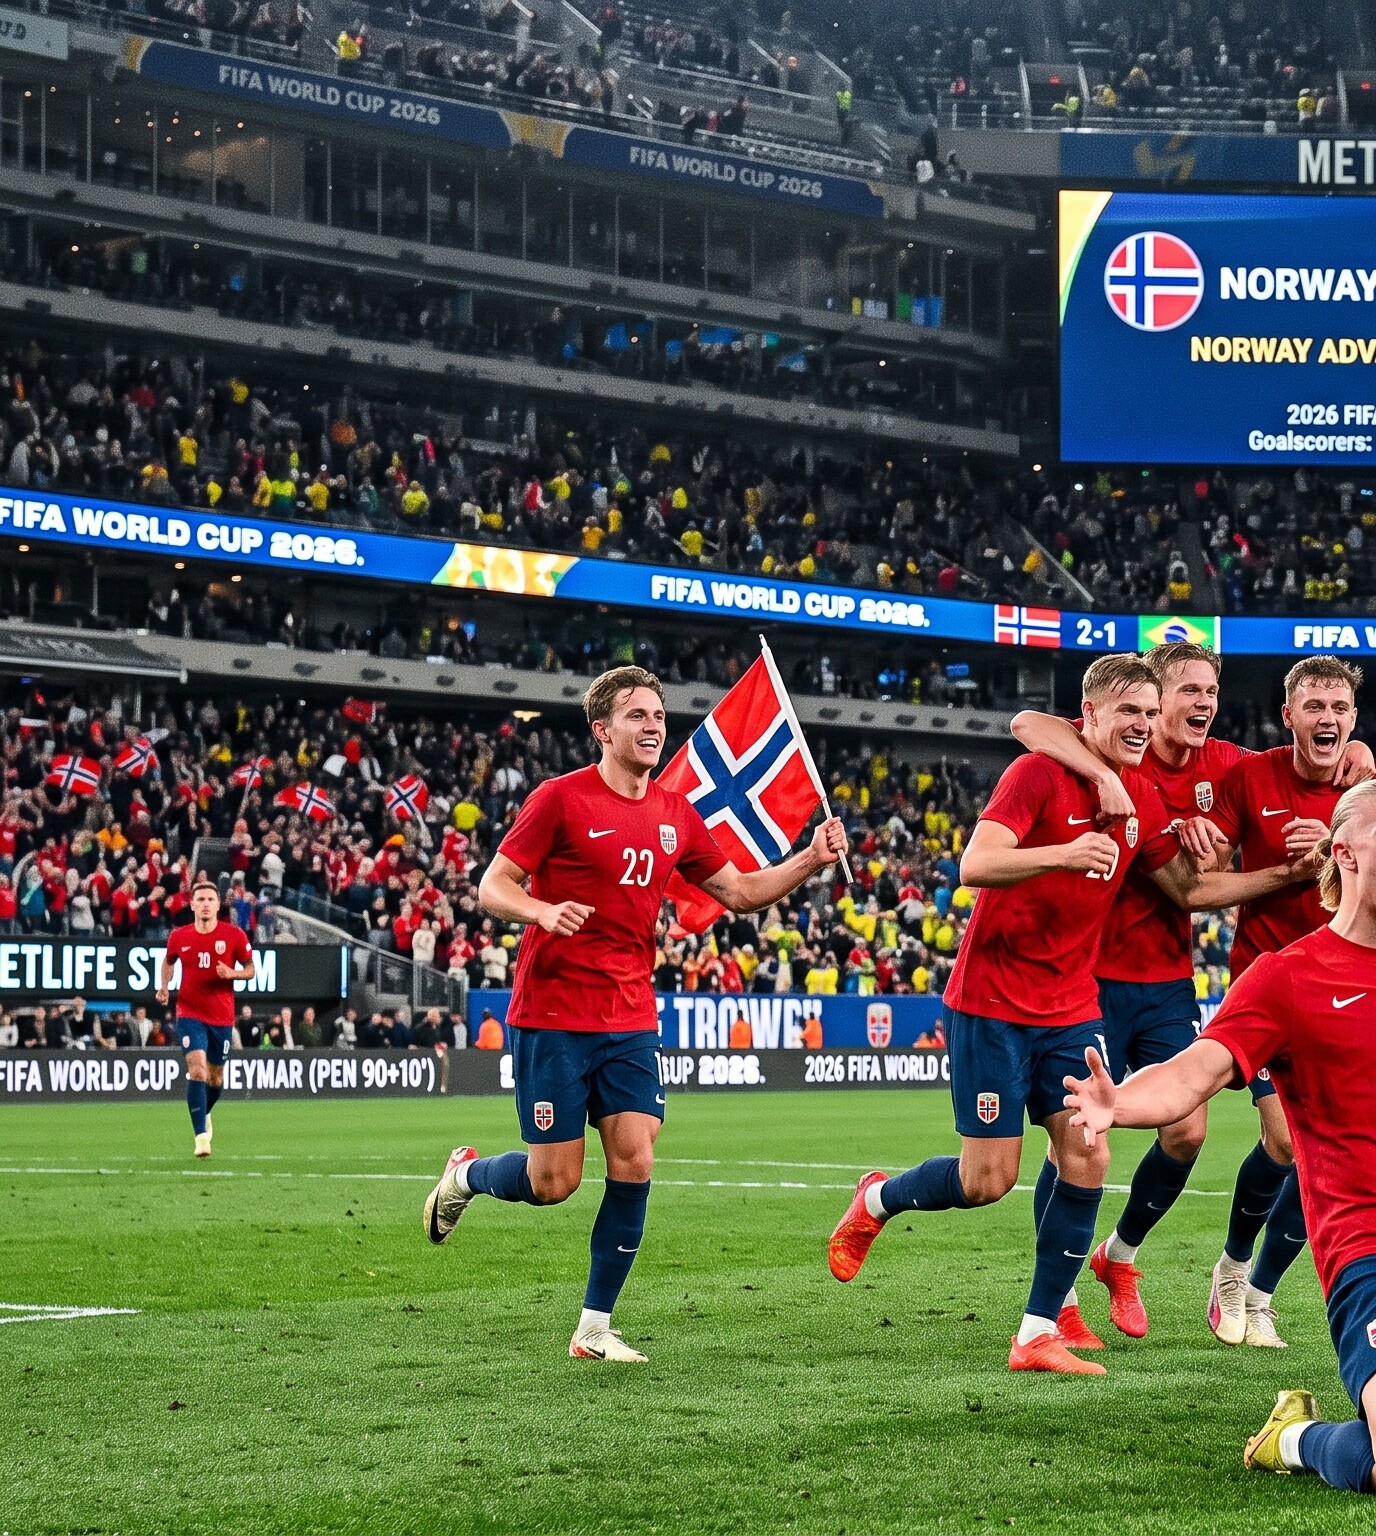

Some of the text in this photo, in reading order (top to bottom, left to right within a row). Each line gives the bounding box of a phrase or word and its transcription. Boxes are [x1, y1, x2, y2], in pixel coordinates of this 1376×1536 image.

[218, 65, 441, 125] FIFA WORLD CUP 2026
[629, 147, 823, 198] FIFA WORLD CUP 2026
[1190, 336, 1313, 364] NORWAY
[1286, 404, 1339, 426] 2026
[1248, 430, 1373, 452] Goalscorers:
[0, 497, 365, 567] FIFA WORLD CUP 2026.
[651, 575, 930, 628] FIFA WORLD CUP 2026.
[1293, 625, 1360, 648] FIFA
[0, 943, 117, 990] ETLIFE
[48, 1059, 129, 1092] WORLD
[134, 1058, 180, 1092] CUP
[309, 1057, 359, 1093] (PEN
[361, 1057, 435, 1093] 90+10')
[698, 1055, 766, 1085] 2026.
[804, 1055, 845, 1083] 2026
[847, 1055, 882, 1082] FIFA
[884, 1054, 939, 1082] WORLD
